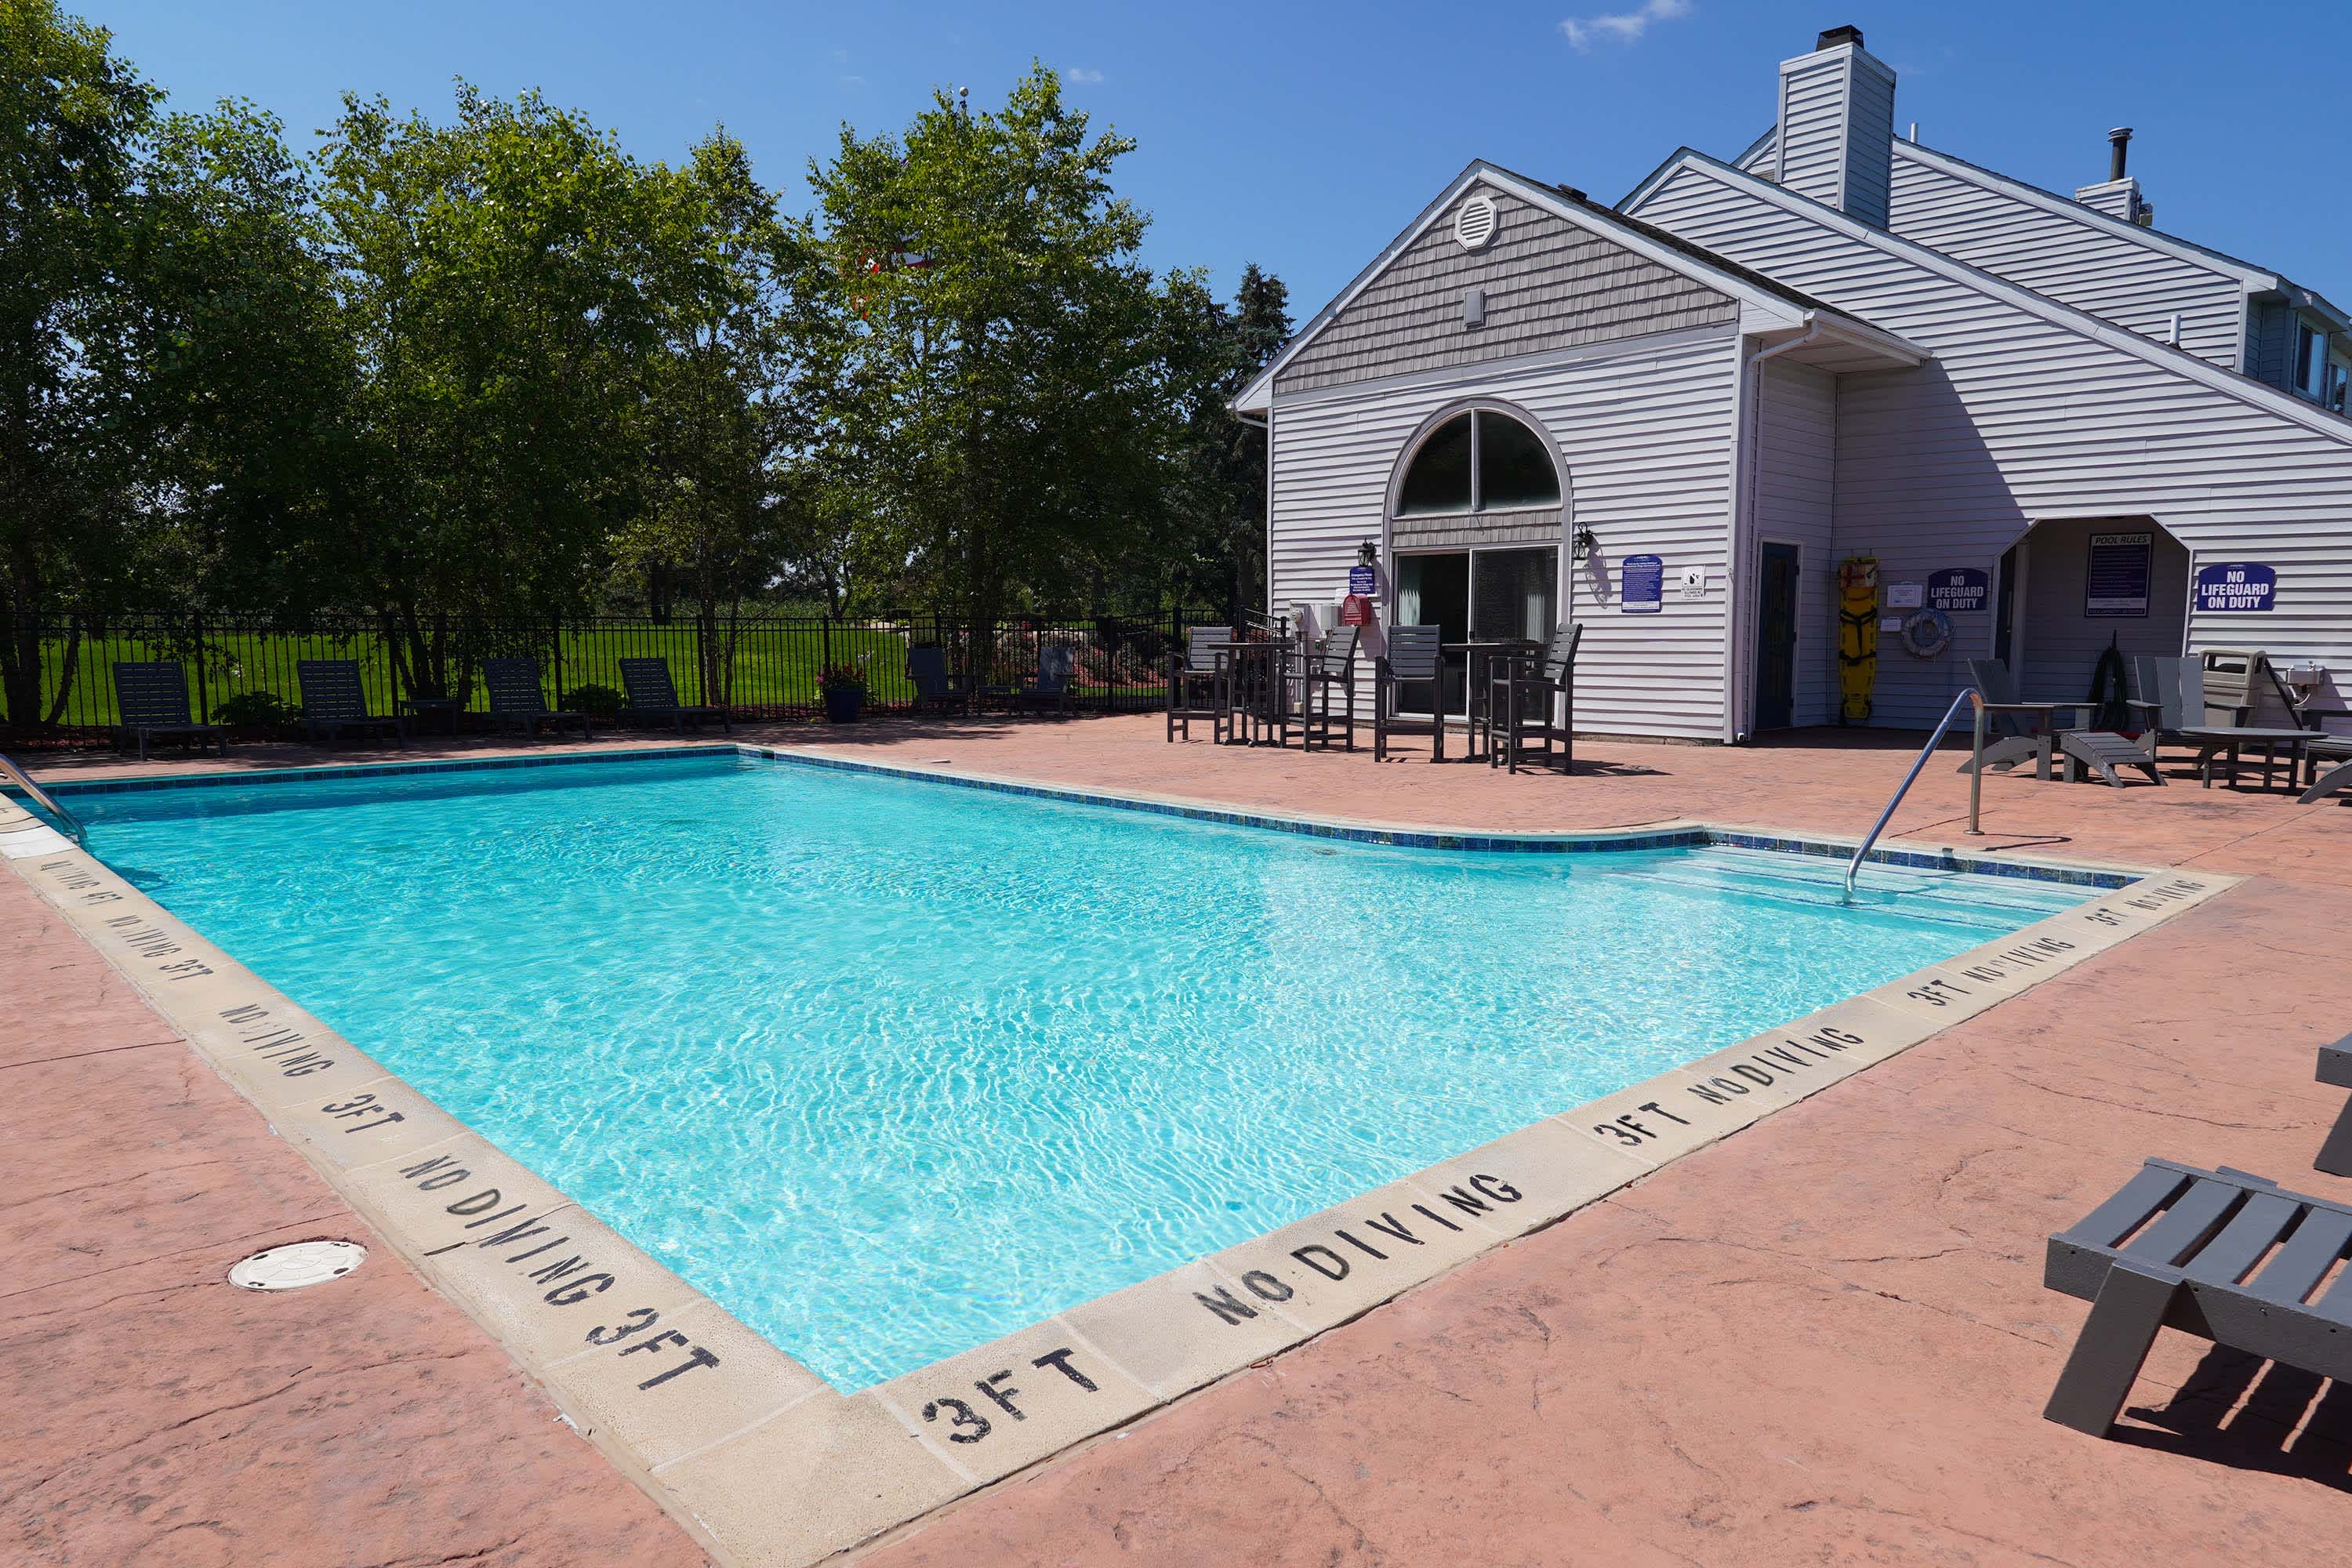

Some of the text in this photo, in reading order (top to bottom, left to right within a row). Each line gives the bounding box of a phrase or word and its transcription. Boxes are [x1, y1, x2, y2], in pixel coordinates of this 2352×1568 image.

[2095, 535, 2147, 545] POOL RULES
[1951, 575, 1965, 586] NO
[2227, 571, 2245, 583] NO
[1931, 586, 1984, 598] LIFEGUARD
[2201, 583, 2269, 596] LIFEGUARD
[1936, 598, 1977, 609] ON DUTY
[2208, 596, 2261, 608] ON DUTY
[2084, 907, 2129, 926] 3FT
[2124, 899, 2162, 911] NO
[114, 925, 182, 957] IVING
[158, 959, 214, 981] 3FT
[1906, 979, 1972, 1007] 3FT
[1960, 966, 2008, 983] NO
[219, 1004, 270, 1024] NO
[321, 1094, 405, 1134] 3FT
[1593, 1027, 1864, 1146] 3FT NO DIVING
[399, 1153, 720, 1391] NO DIVING 3FT
[921, 1174, 1524, 1443] 3FT NO DIVING
